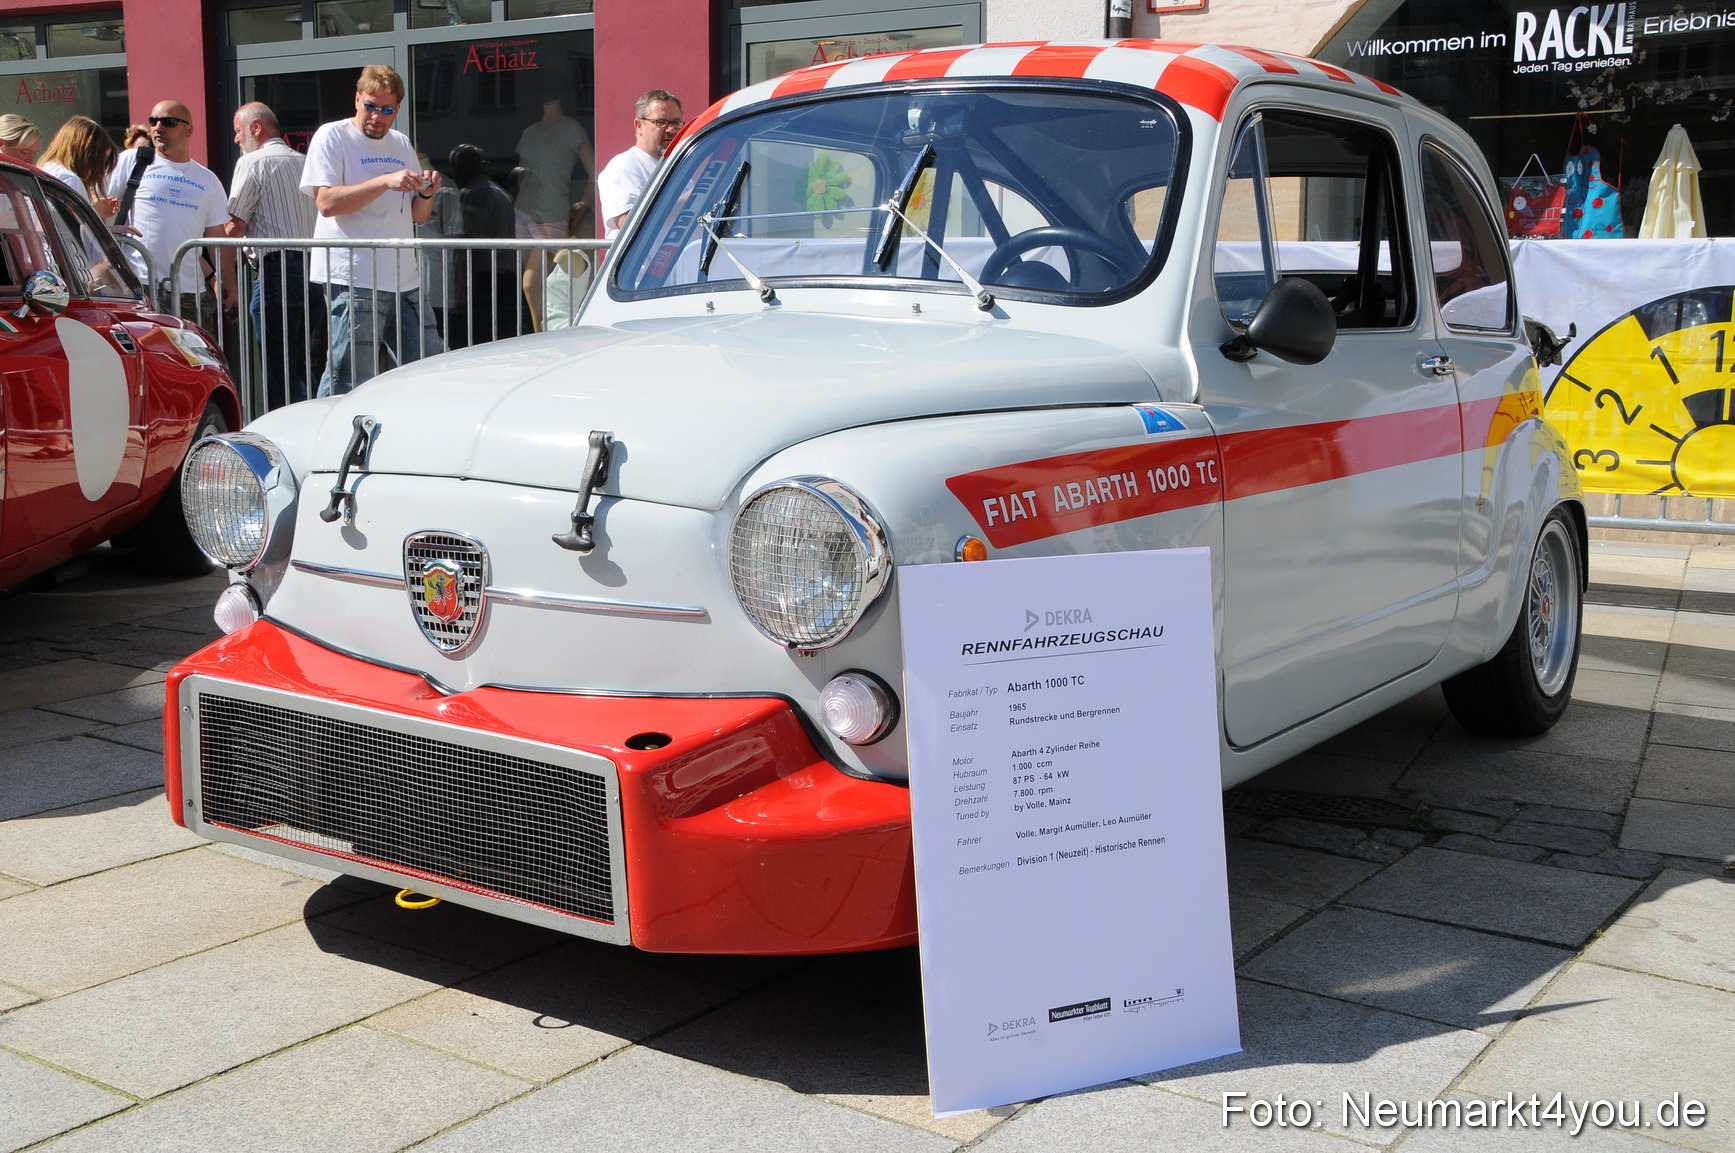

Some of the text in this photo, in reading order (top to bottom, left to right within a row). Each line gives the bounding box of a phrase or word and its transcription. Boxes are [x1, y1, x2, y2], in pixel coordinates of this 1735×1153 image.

[1513, 2, 1633, 62] RACKL
[1625, 1, 1637, 45] AM RATHAUS
[1643, 8, 1735, 35] Erlebnis
[1347, 31, 1506, 57] Willkommen im
[463, 44, 537, 74] Achatz
[1513, 56, 1632, 74] Jeden Tag genießen.
[16, 79, 76, 104] Achatz
[149, 195, 167, 203] MINI
[169, 199, 199, 210] Meeting
[1650, 345, 1680, 385] 1
[1594, 388, 1643, 425] 2
[1573, 449, 1620, 472] 3
[982, 459, 1218, 527] FIAT ABARTH 1000 TC
[1045, 607, 1093, 627] DEKRA
[961, 625, 1164, 656] RENNFAHRZEUGSCHAU
[948, 687, 979, 698] Fabrikat
[985, 686, 998, 697] Typ
[1007, 679, 1042, 694] Abarth
[1044, 677, 1069, 689] 1000
[1071, 675, 1085, 687] TC
[949, 703, 1027, 720] Baujahr 1965
[950, 706, 1121, 732] Einsatz Rundstrecke und Bergrennen
[952, 756, 975, 766] Motor
[1011, 748, 1038, 758] Abarth
[1045, 743, 1077, 755] Zylinder
[1079, 740, 1101, 750] Reihe
[953, 760, 1053, 779] Hubraum 1.000 ccm
[953, 782, 986, 794] Leistung
[1012, 776, 1023, 785] 87
[1024, 774, 1035, 783] PS
[1043, 772, 1053, 781] 64
[1057, 770, 1070, 779] kW
[954, 786, 1054, 806] Drehzahl 7.800. rpm
[955, 797, 1072, 821] Tuned by by Volle, Mainz
[957, 812, 1152, 847] Fahrer Volle, Margit Aumüller, Leo Aumüller
[958, 859, 1011, 876] Bemerkungen
[1016, 852, 1048, 867] Division
[1055, 846, 1089, 862] (Neuzeit)
[1095, 840, 1136, 854] Historische
[1138, 836, 1166, 847] Rennen
[1051, 1001, 1109, 1020] Neumarkter Tagblatt
[1002, 1016, 1036, 1031] DEKRA
